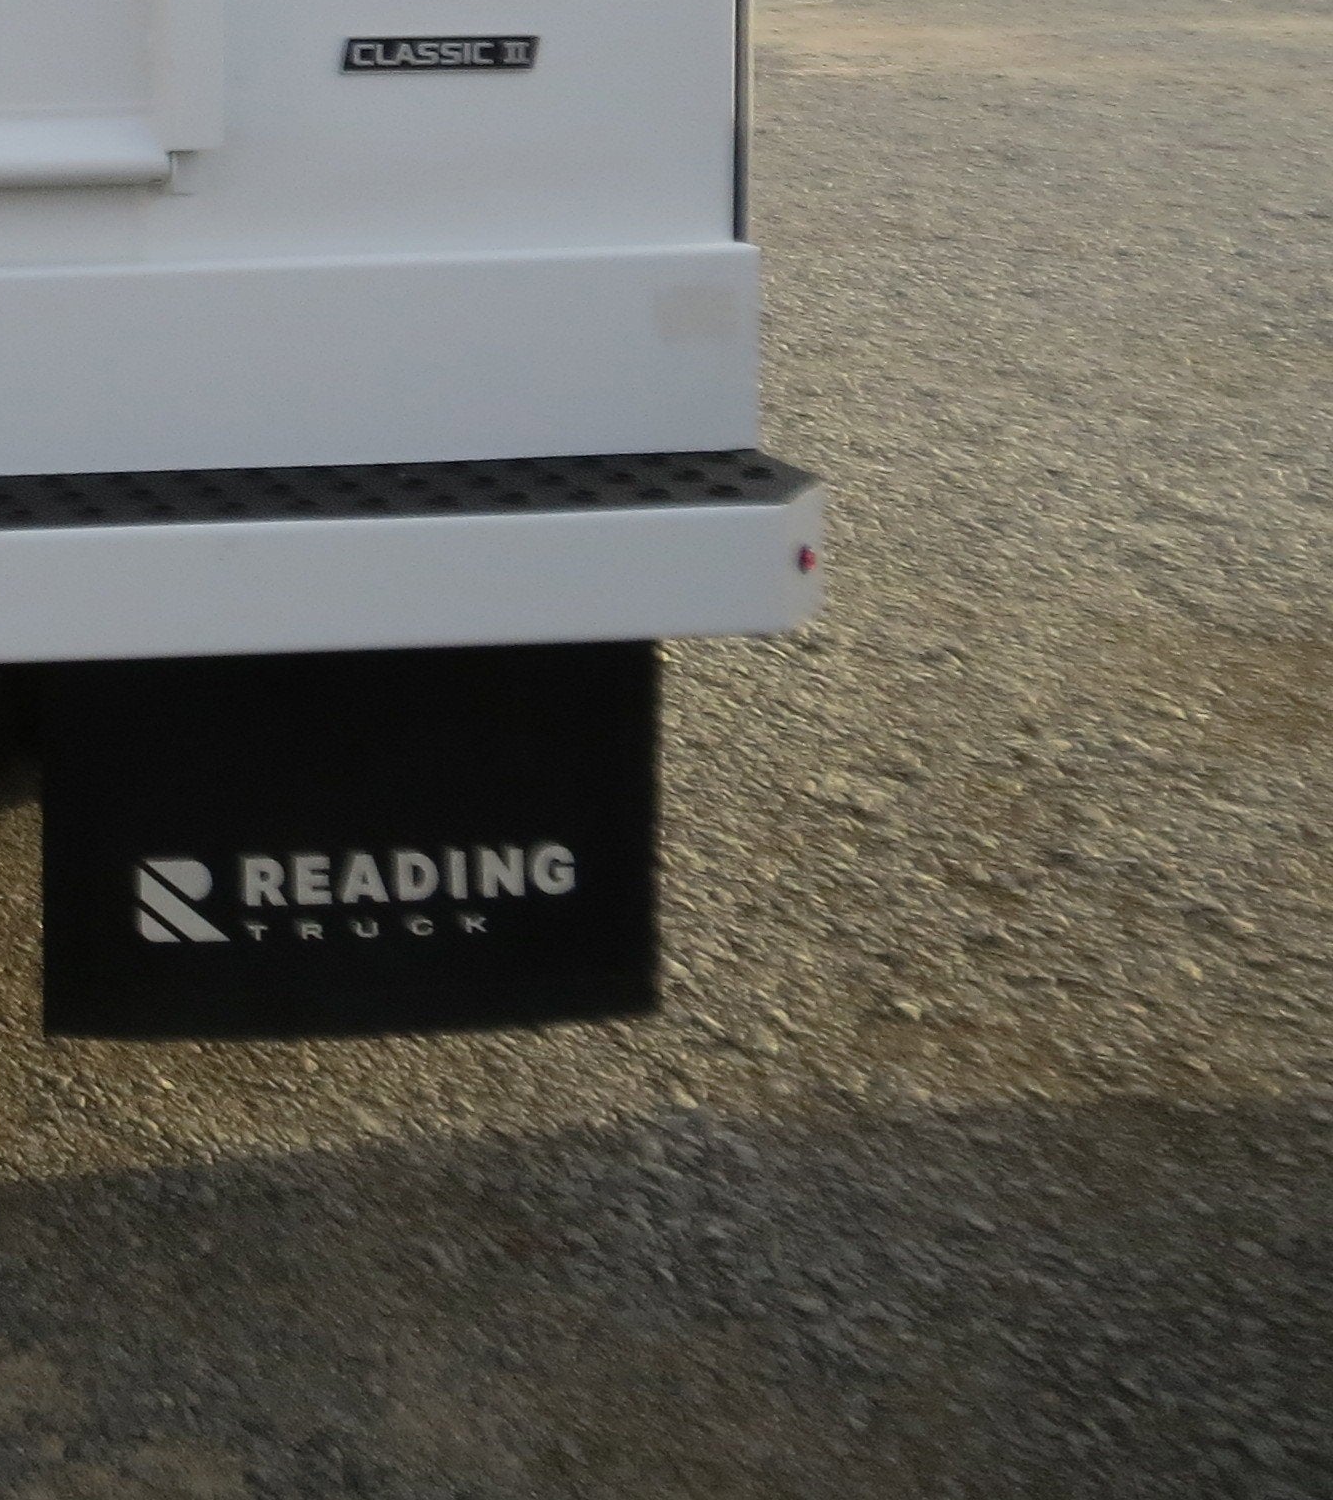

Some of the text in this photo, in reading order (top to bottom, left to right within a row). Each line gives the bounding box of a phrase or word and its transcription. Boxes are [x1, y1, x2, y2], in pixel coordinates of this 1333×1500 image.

[351, 41, 495, 66] CLASSIC
[241, 842, 577, 908] READING
[245, 915, 489, 942] TRUCK
